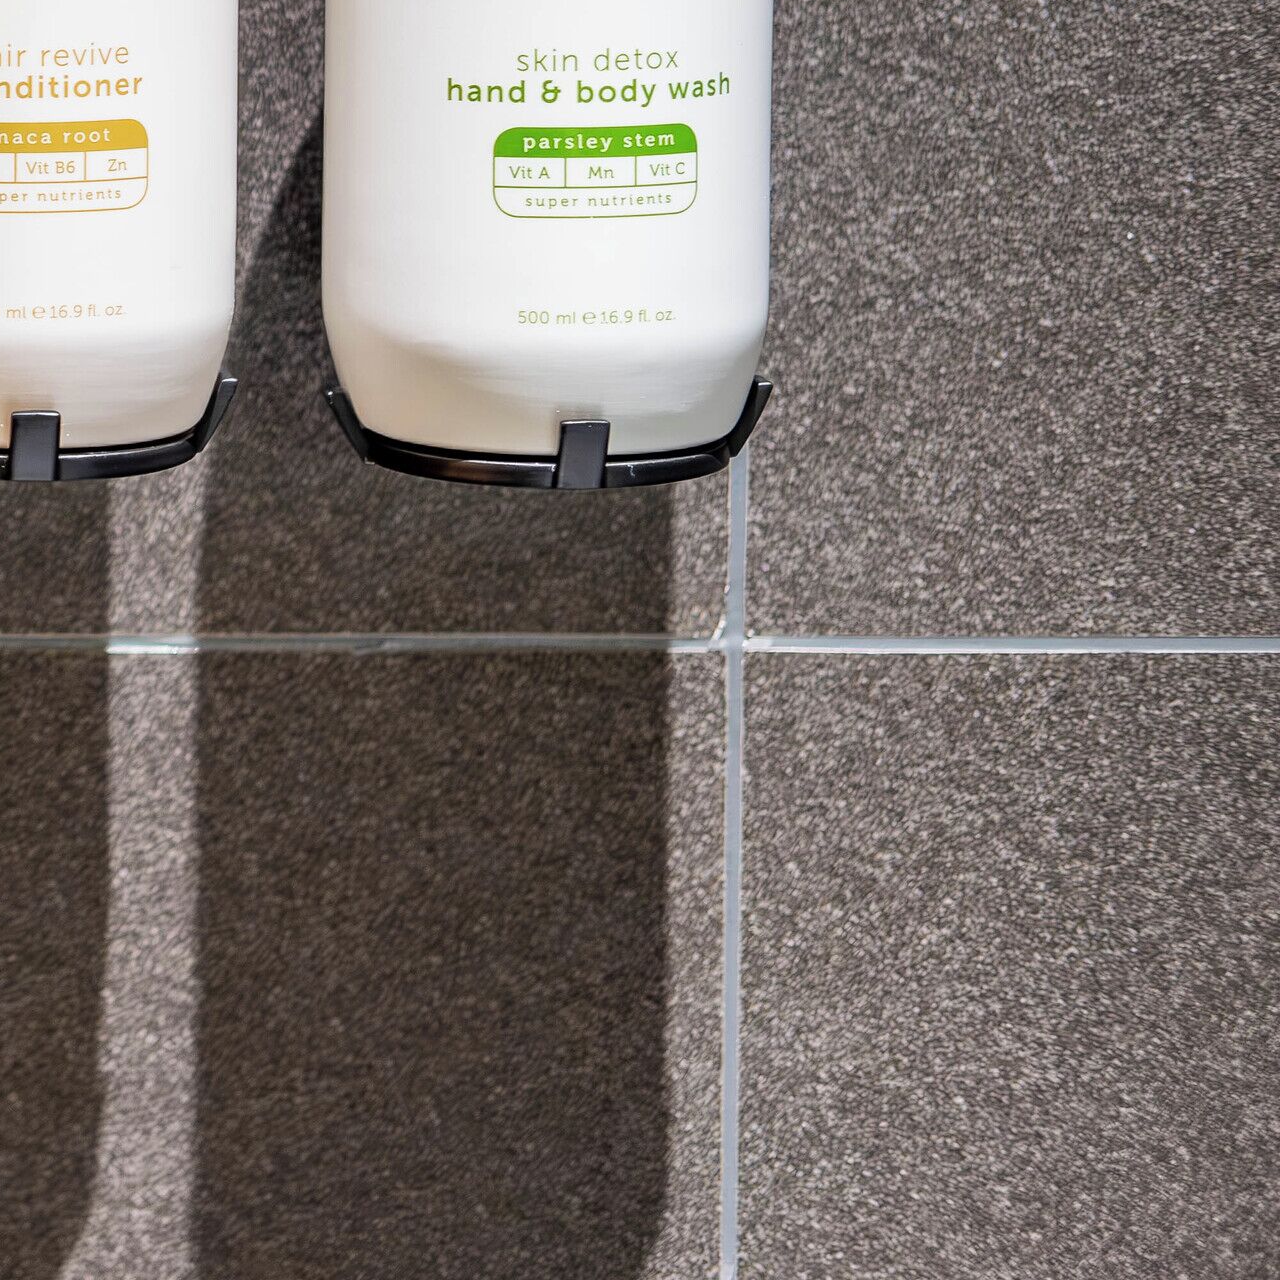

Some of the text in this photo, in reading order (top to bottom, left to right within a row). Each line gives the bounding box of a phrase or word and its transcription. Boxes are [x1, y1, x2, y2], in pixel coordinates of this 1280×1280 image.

[41, 42, 130, 67] revive
[516, 48, 678, 72] skin detox
[446, 72, 730, 108] hand & body wash
[63, 128, 111, 144] root
[522, 132, 676, 152] parsley stem
[25, 160, 76, 174] Vit B6
[108, 158, 128, 172] Zn
[650, 162, 686, 176] Vit C
[509, 166, 551, 179] Vit A
[588, 166, 614, 179] Mn
[38, 189, 122, 202] nutrients
[526, 192, 672, 210] super nutrients
[6, 305, 26, 319] ml
[50, 304, 82, 318] 16.9
[518, 310, 550, 324] 500
[556, 311, 576, 324] ml
[600, 310, 633, 324] 16.9
